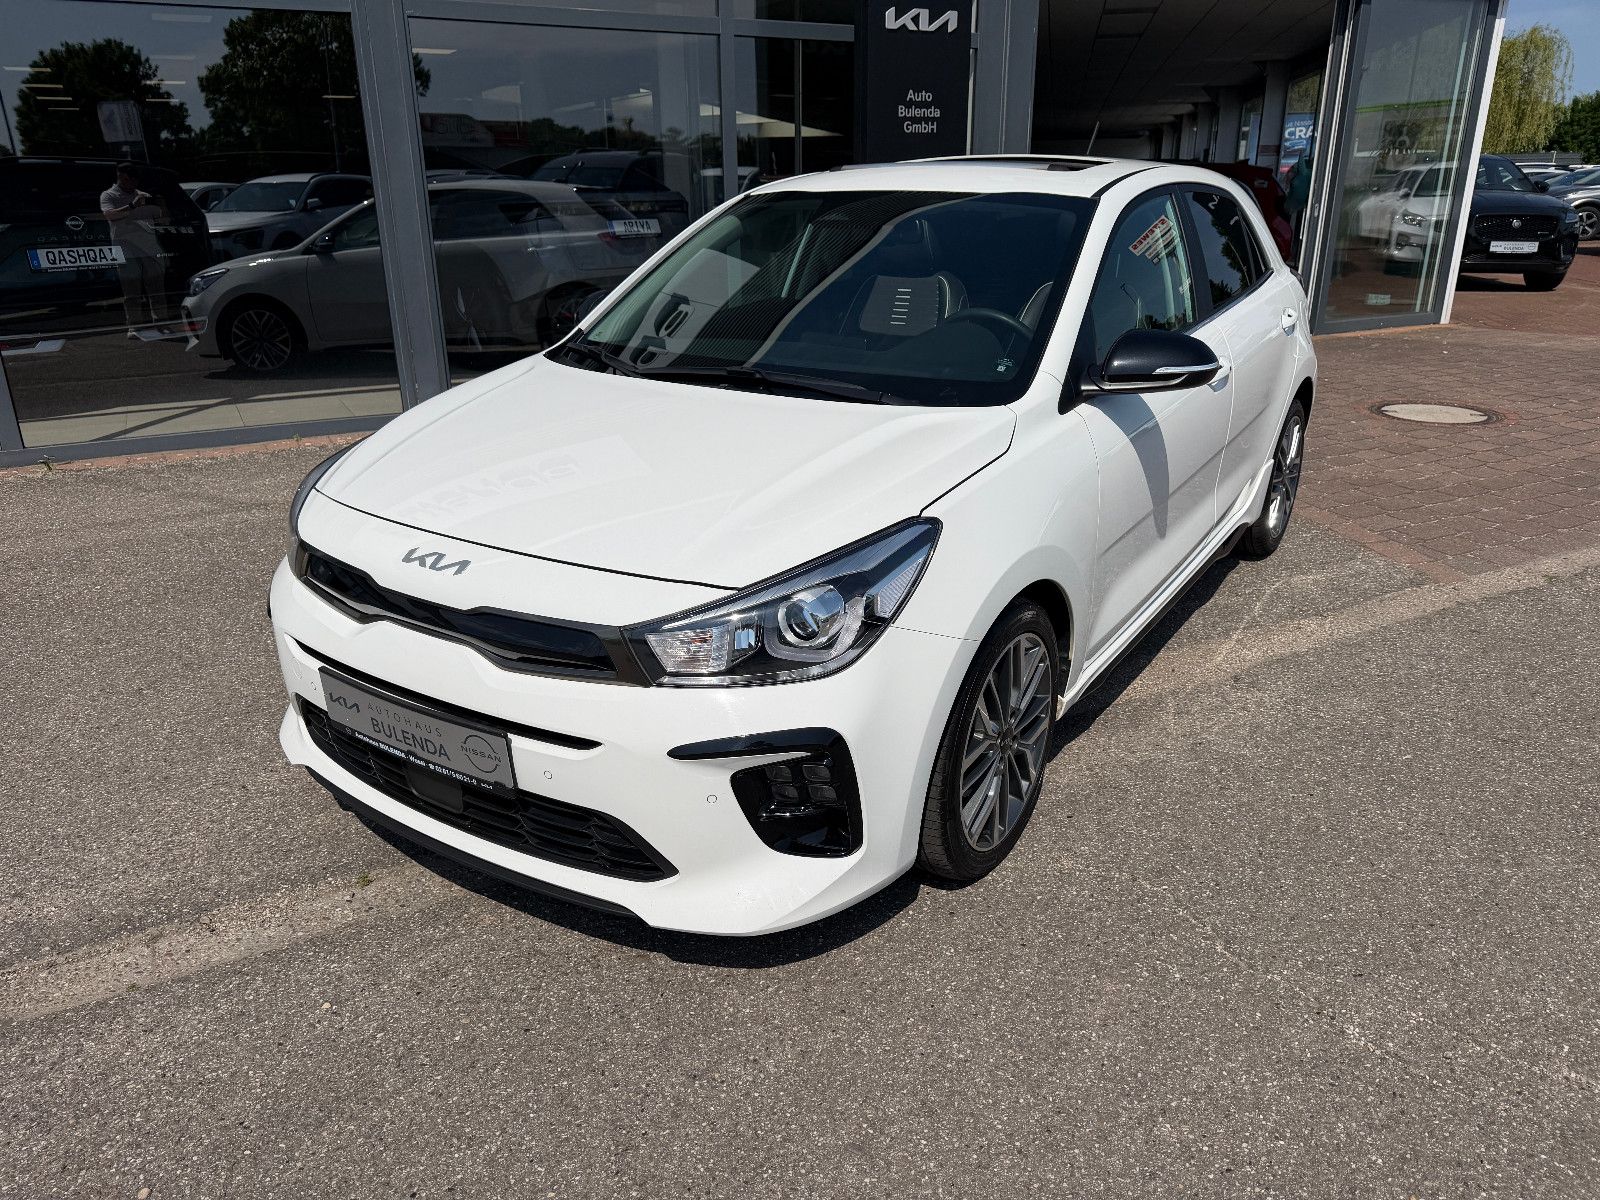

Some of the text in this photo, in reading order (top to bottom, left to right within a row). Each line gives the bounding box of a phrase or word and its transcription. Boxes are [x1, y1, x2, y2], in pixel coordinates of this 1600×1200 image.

[885, 6, 958, 33] KIA
[906, 89, 933, 102] Auto
[898, 105, 941, 118] Bulenda
[903, 120, 937, 133] GmbH
[46, 246, 118, 266] QASHQAI
[401, 547, 472, 576] KIA
[367, 702, 442, 737] AUTOHAUS
[370, 717, 451, 761] BULENDA
[459, 744, 502, 764] NISSAN
